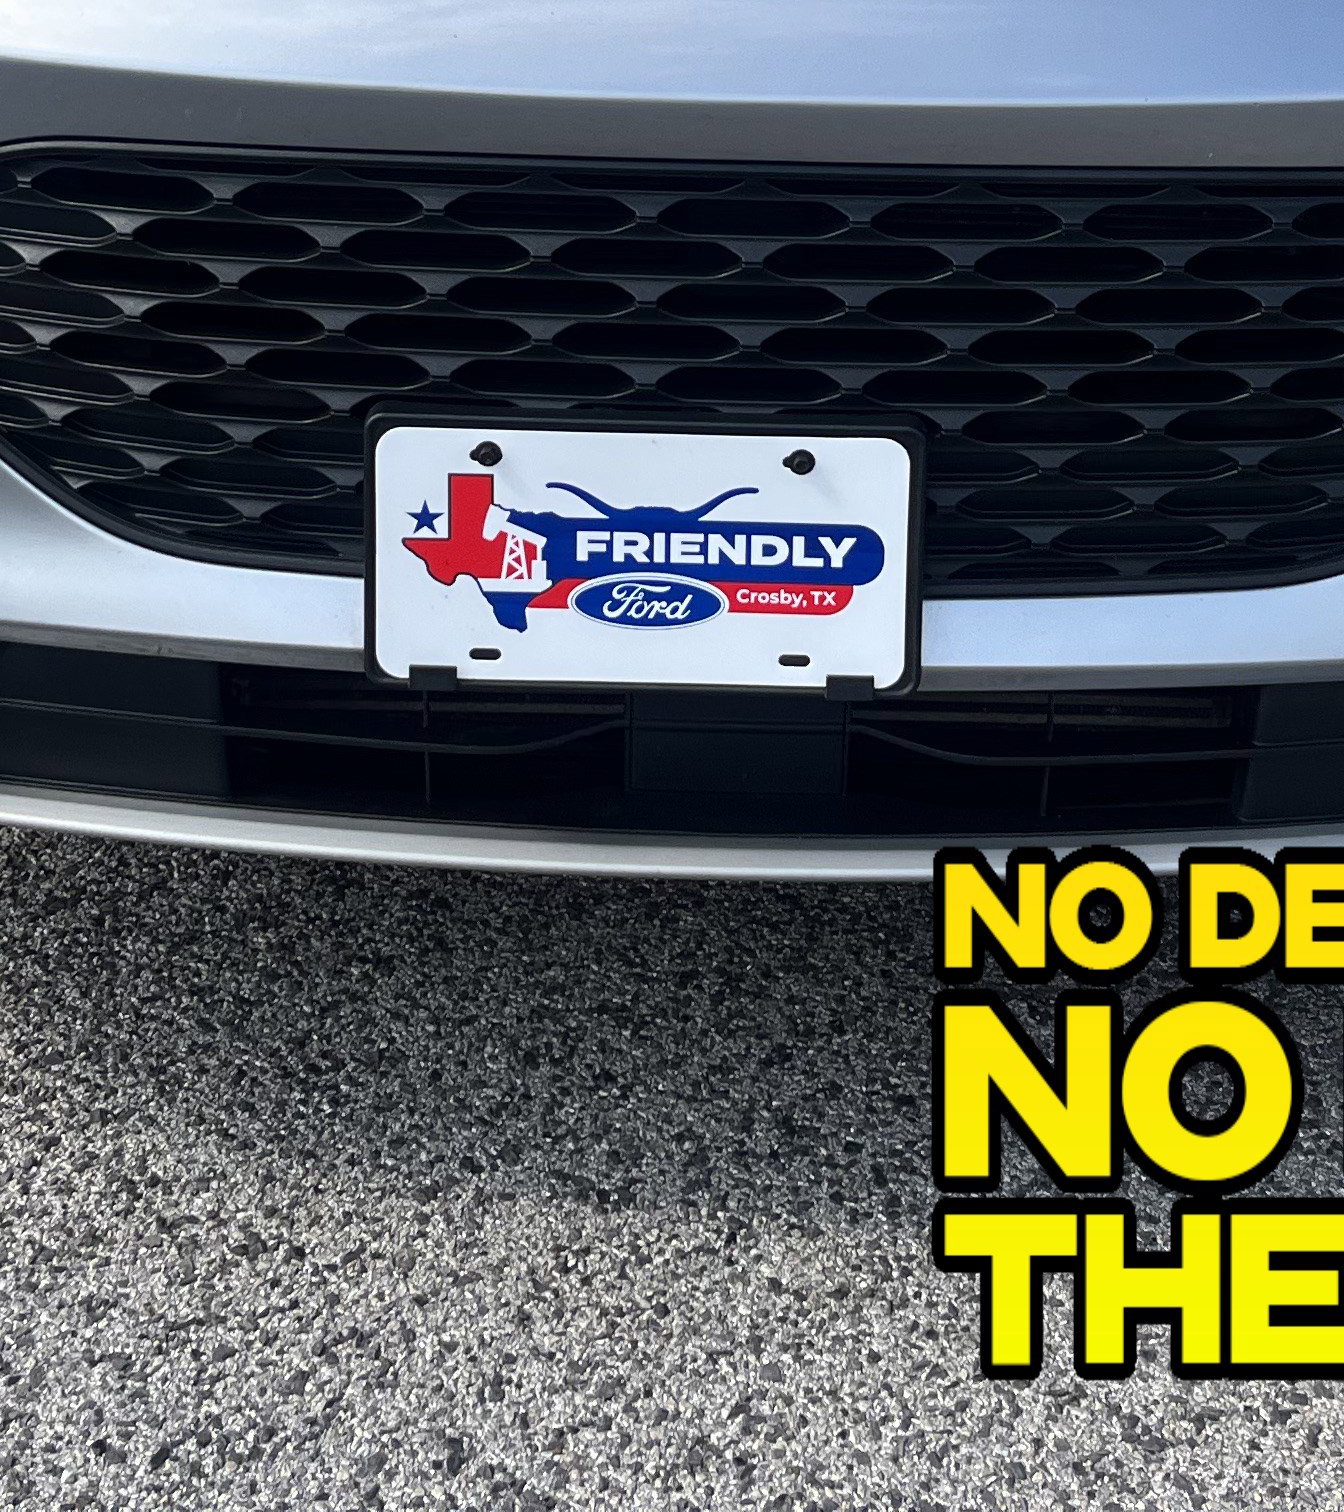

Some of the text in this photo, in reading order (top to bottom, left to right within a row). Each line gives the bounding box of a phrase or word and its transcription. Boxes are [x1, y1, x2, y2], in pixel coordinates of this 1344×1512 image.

[575, 530, 857, 568] FRIENDLY
[602, 582, 693, 620] Ford
[735, 588, 837, 608] Crosby, TX
